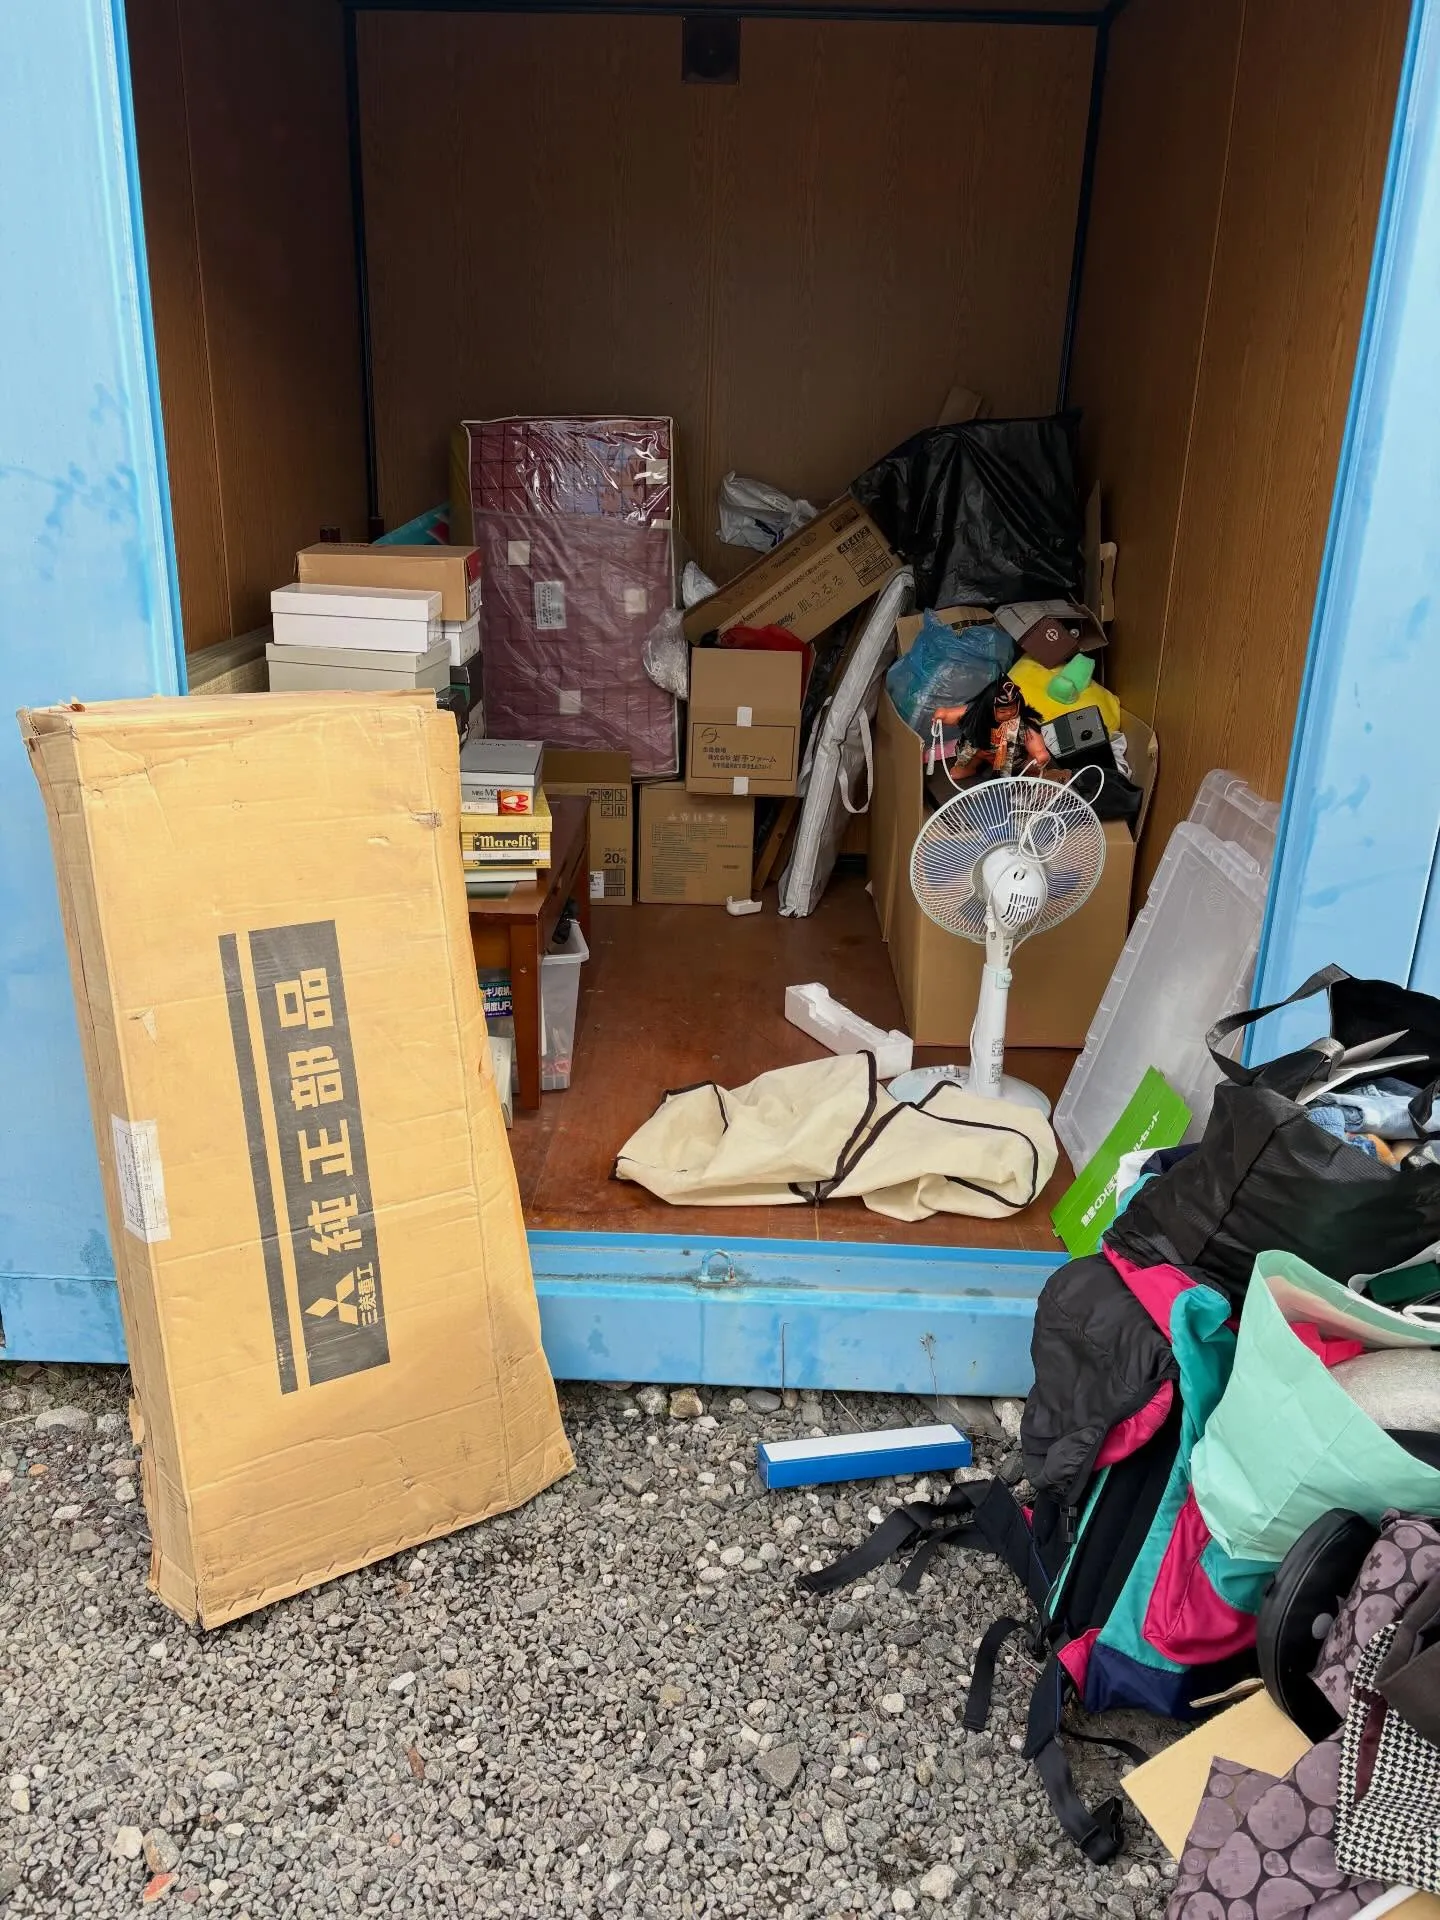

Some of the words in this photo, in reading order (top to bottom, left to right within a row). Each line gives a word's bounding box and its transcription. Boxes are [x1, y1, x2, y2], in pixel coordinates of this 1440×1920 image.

[274, 967, 364, 1256] 純正部品
[355, 1261, 379, 1327] 三菱重工
